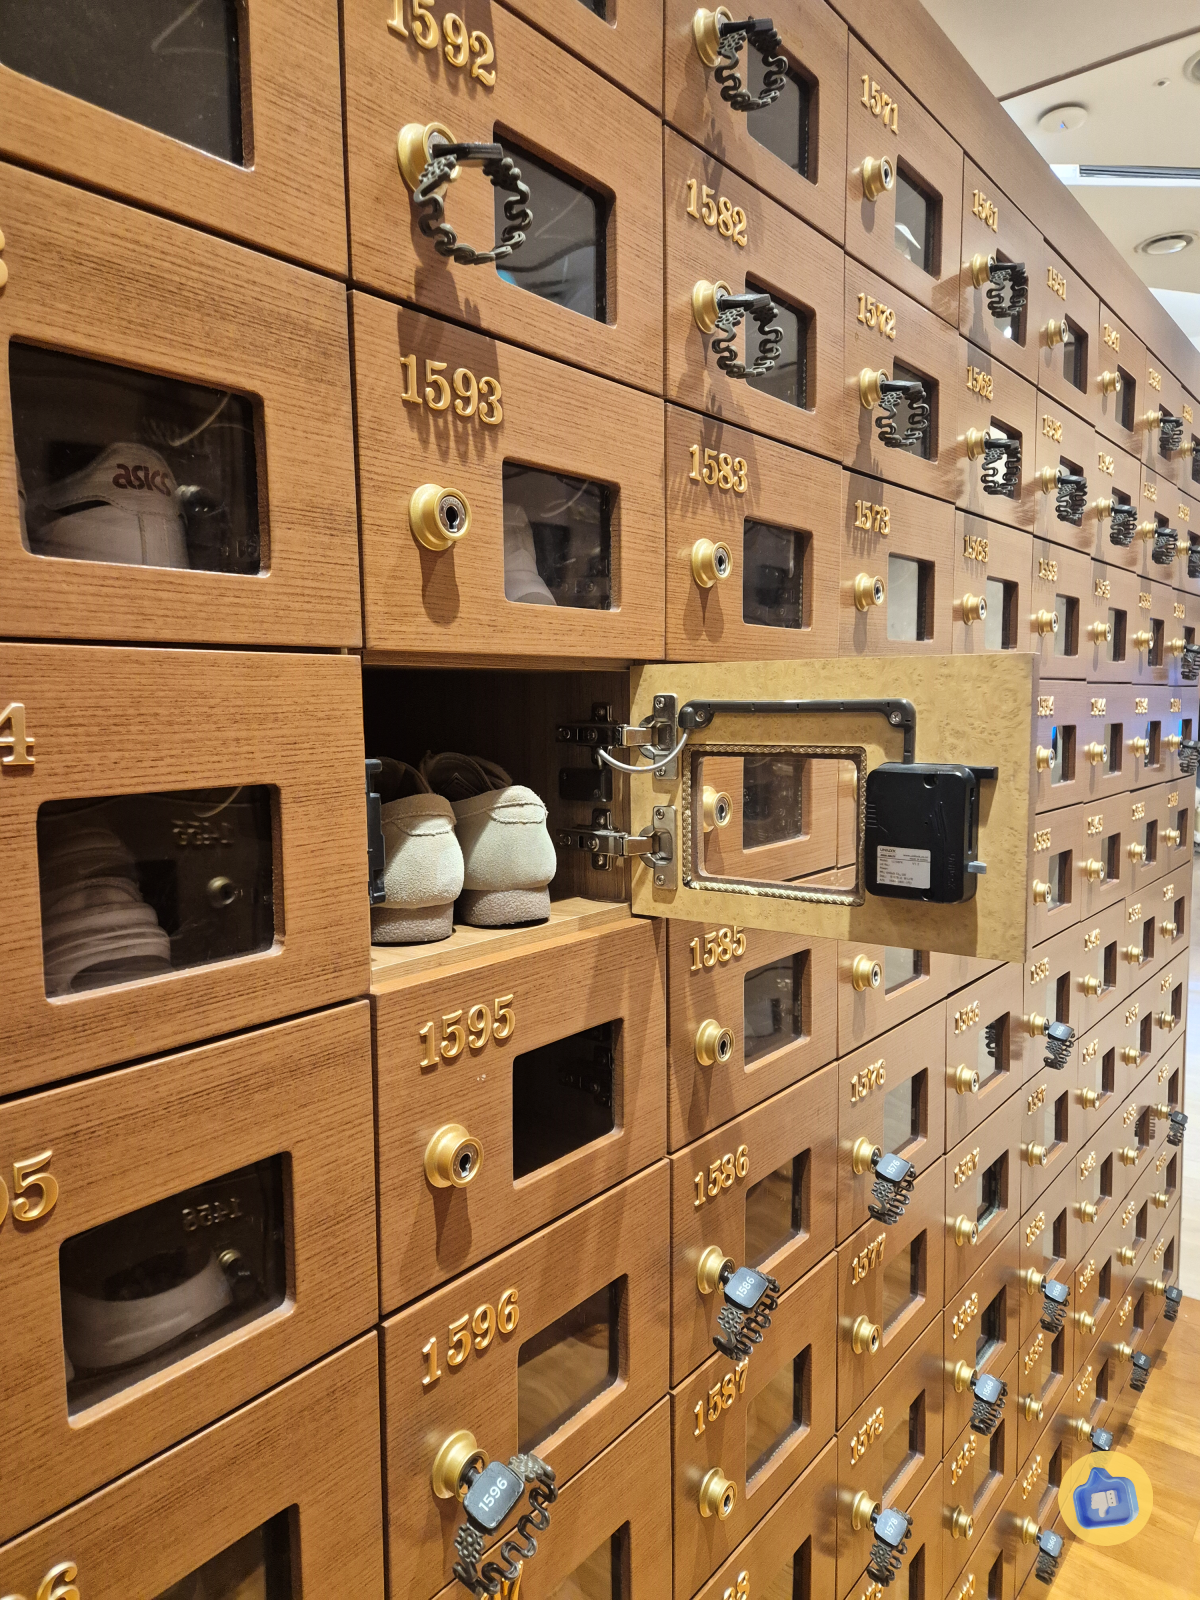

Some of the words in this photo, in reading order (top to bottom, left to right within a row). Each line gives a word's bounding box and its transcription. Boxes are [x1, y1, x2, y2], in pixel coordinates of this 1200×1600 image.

[387, 0, 496, 86] 1592
[861, 75, 898, 134] 1571
[687, 179, 748, 246] 1582
[972, 190, 998, 233] 1561
[858, 292, 896, 339] 1572
[400, 354, 502, 425] 1593
[966, 365, 993, 400] 1562
[112, 464, 171, 496] asics
[689, 444, 748, 493] 1583
[854, 500, 890, 535] 1573
[963, 535, 989, 563] 1563
[690, 926, 746, 971] 1585
[419, 994, 516, 1069] 1595
[954, 1000, 980, 1034] 1566
[850, 1059, 886, 1102] 1576
[694, 1145, 750, 1206] 1586
[886, 1160, 900, 1174] 1576
[954, 1147, 980, 1188] 1567
[852, 1232, 886, 1285] 1577
[736, 1276, 754, 1297] 1586
[421, 1288, 520, 1387] 1596
[952, 1292, 978, 1339] 1568
[694, 1357, 748, 1437] 1587
[983, 1380, 994, 1396] 1568
[850, 1407, 884, 1465] 1578
[951, 1434, 976, 1485] 1569
[478, 1477, 508, 1512] 1596
[885, 1518, 898, 1536] 1578
